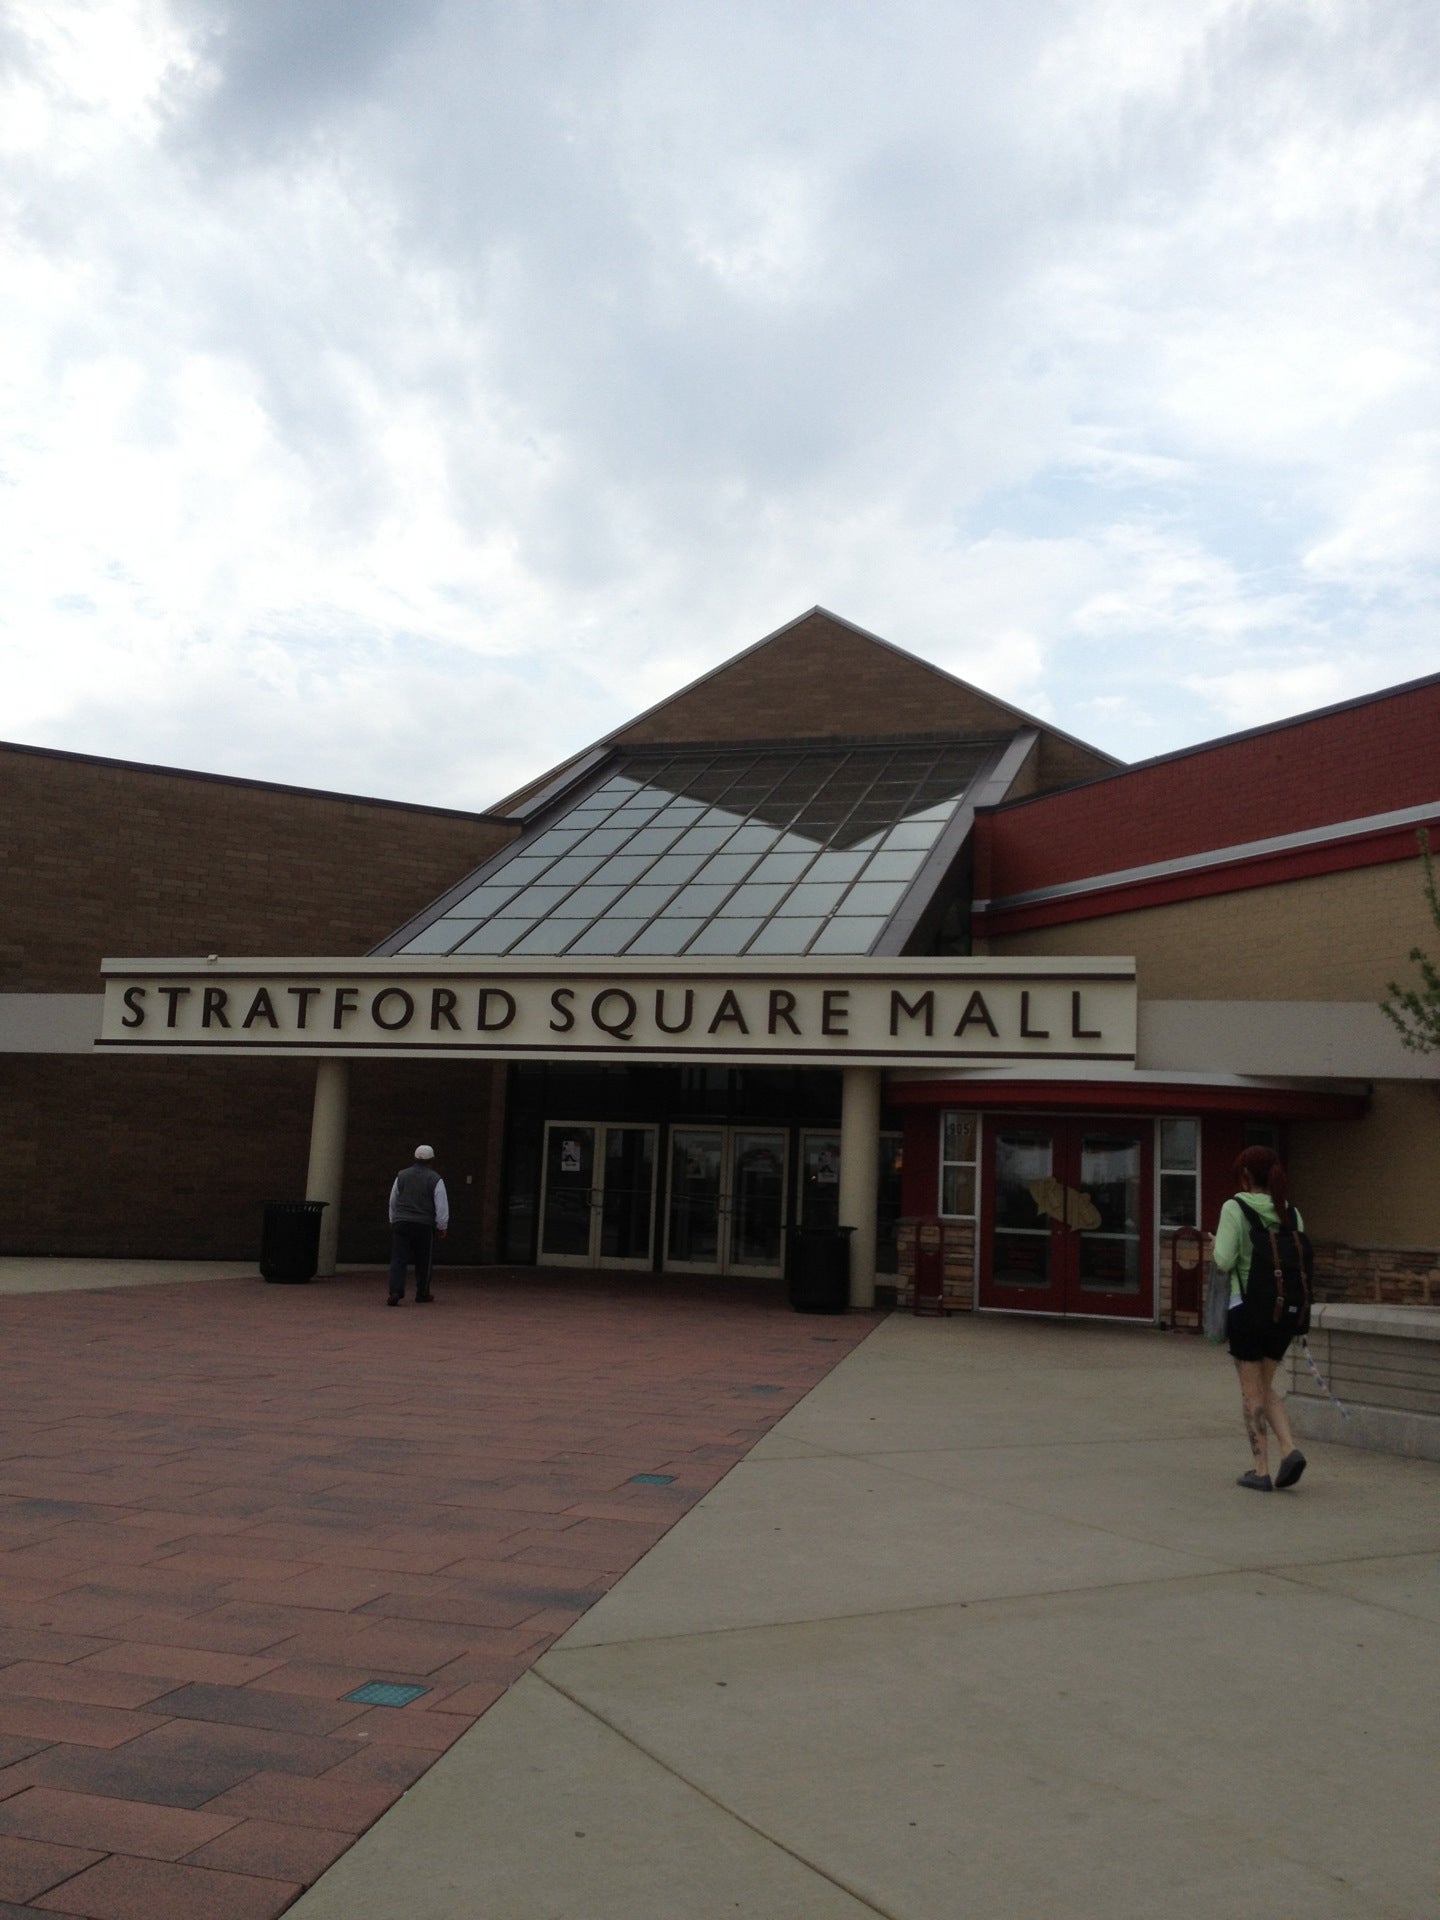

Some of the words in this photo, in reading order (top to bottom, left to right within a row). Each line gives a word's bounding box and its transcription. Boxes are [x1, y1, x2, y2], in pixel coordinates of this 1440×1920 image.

[121, 986, 517, 1032] STRATFORD
[548, 987, 850, 1041] SQUARE
[888, 989, 1103, 1038] MALL
